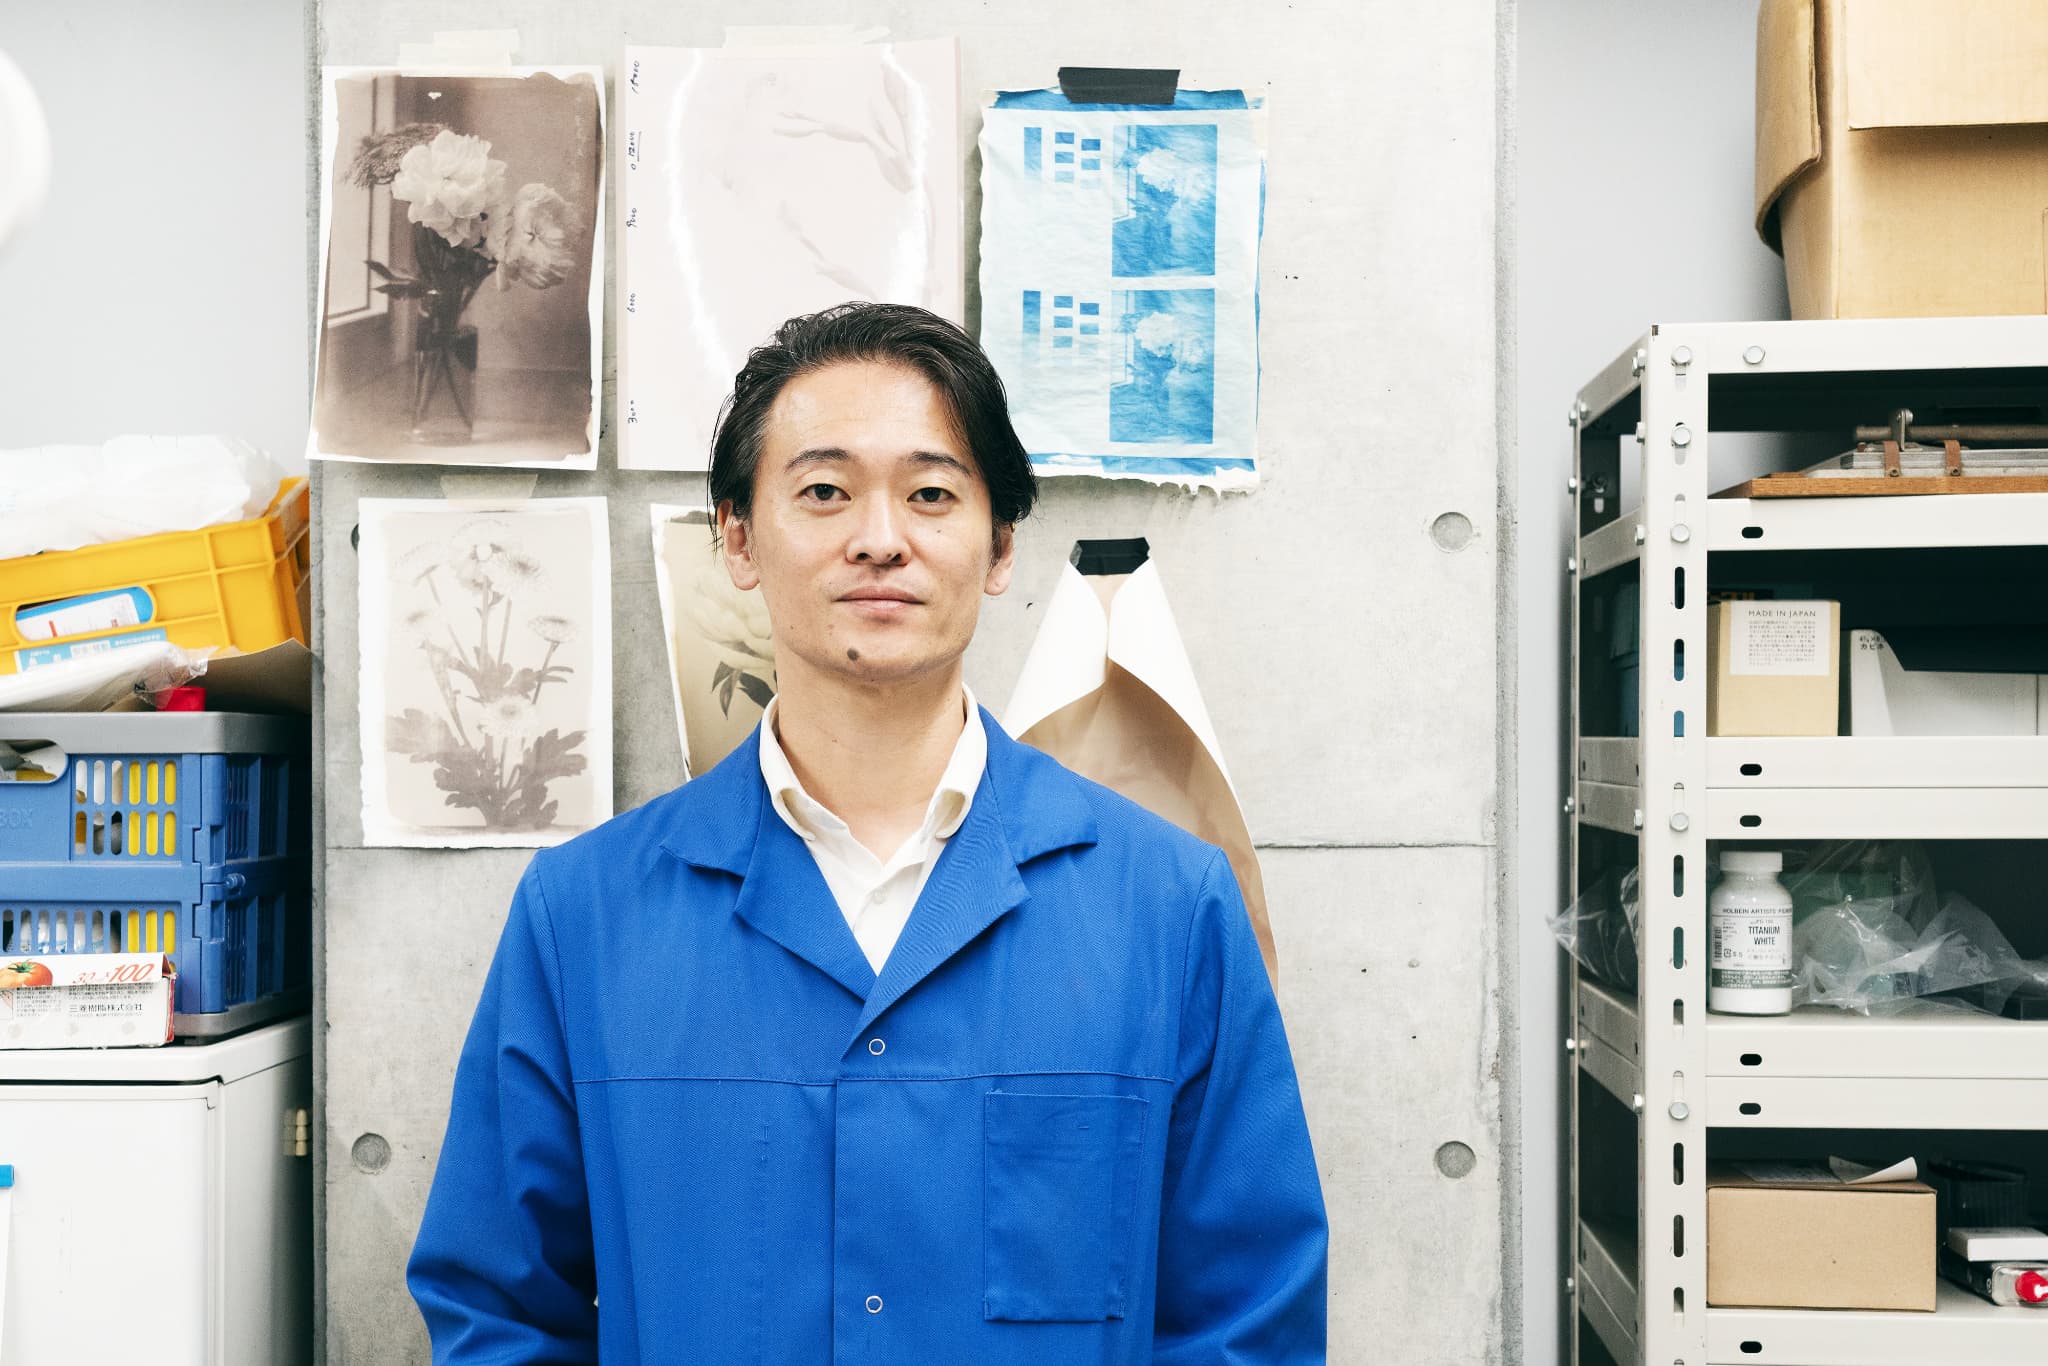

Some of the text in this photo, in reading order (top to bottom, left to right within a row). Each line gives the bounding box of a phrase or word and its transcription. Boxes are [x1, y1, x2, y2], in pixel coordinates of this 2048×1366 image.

[1748, 610, 1817, 619] MADE IN JAPAN
[1748, 926, 1780, 934] TITANIUM
[1753, 936, 1775, 945] WHITE
